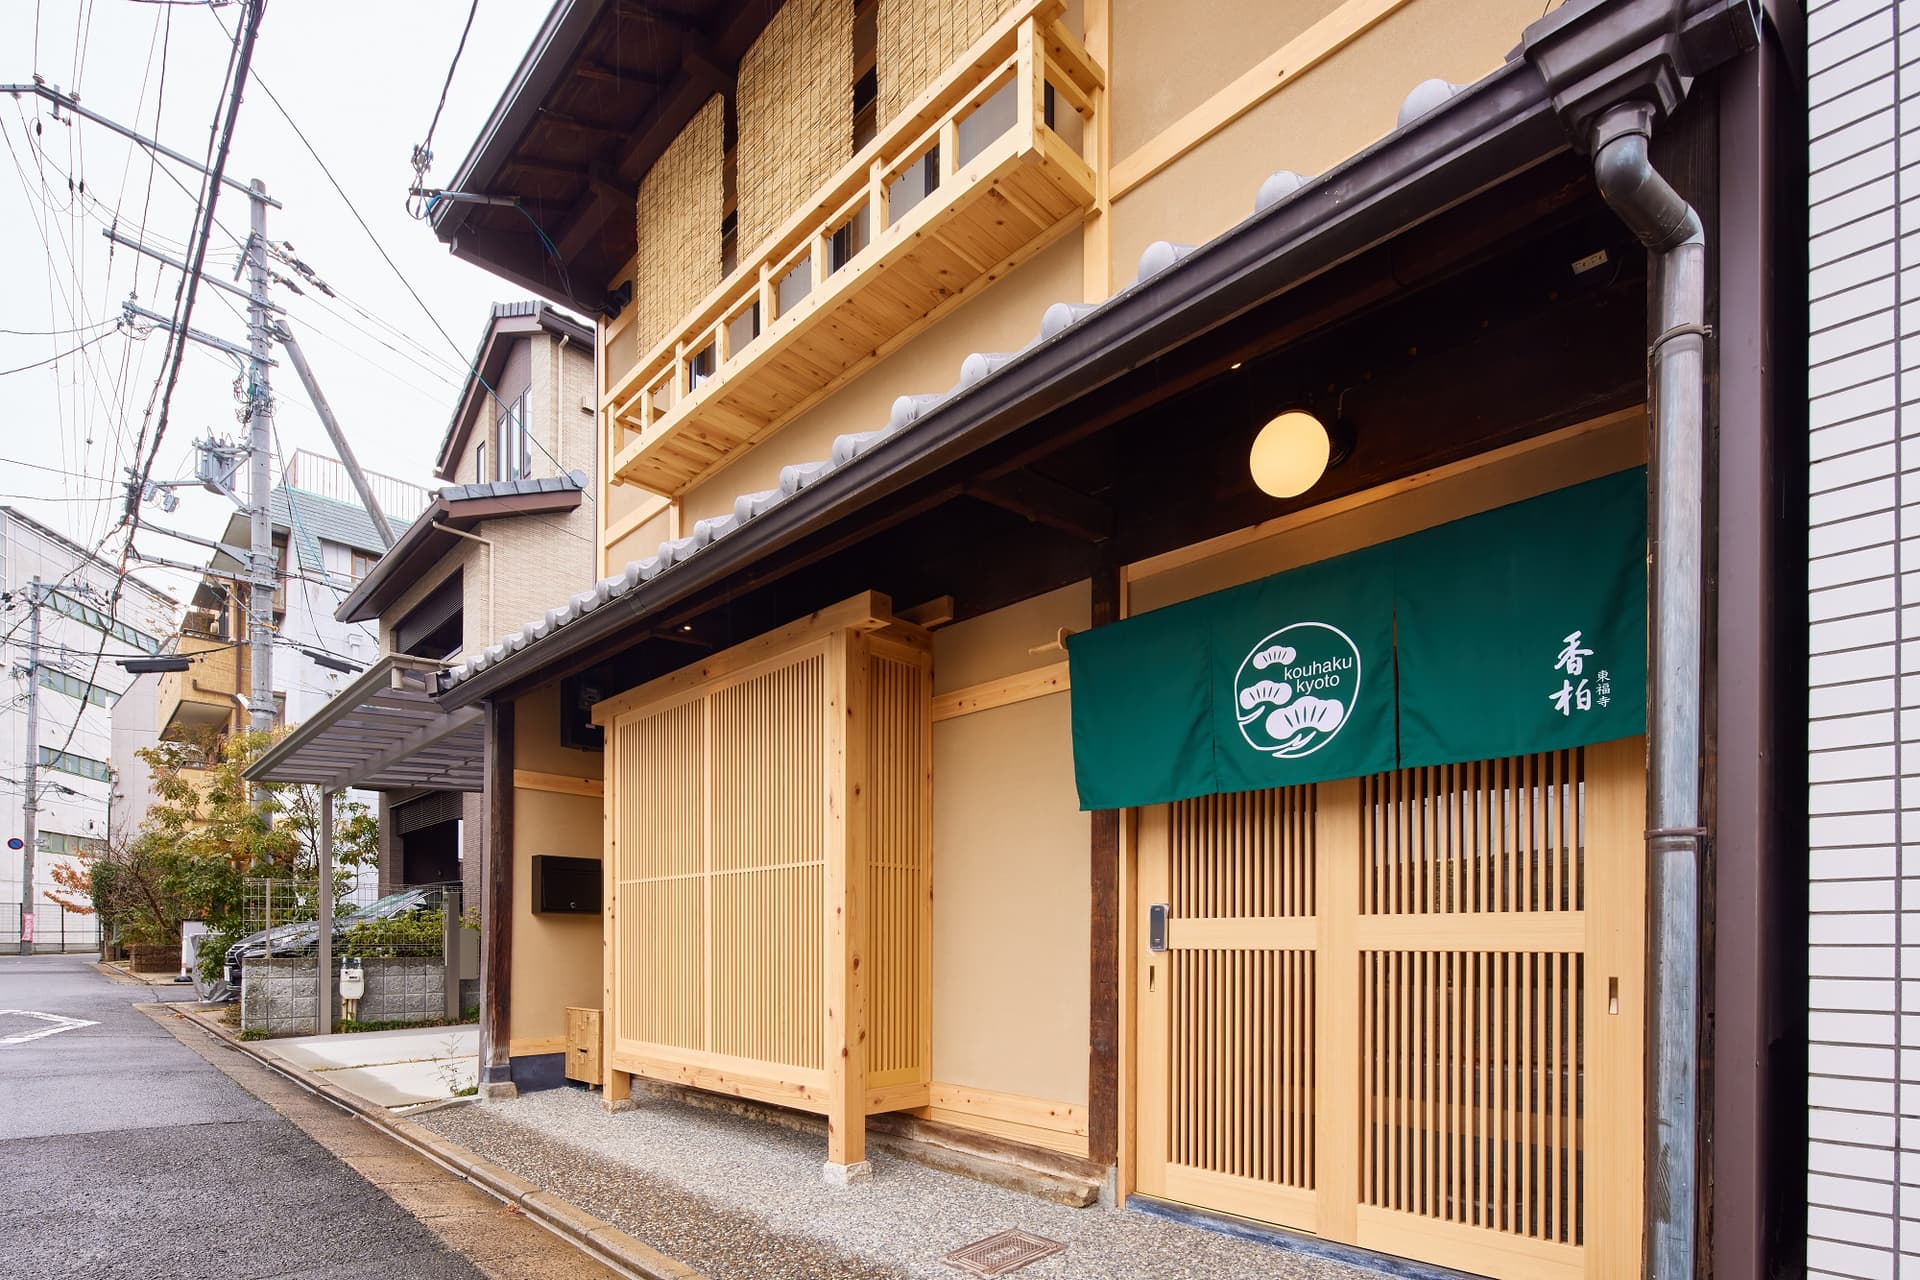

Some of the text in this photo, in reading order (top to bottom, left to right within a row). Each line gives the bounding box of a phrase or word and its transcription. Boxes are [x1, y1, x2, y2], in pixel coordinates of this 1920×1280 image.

[1284, 656, 1352, 680] kouhaku
[1548, 630, 1594, 717] 香柏
[1296, 675, 1340, 695] kyoto
[1596, 670, 1611, 707] 東福寺
